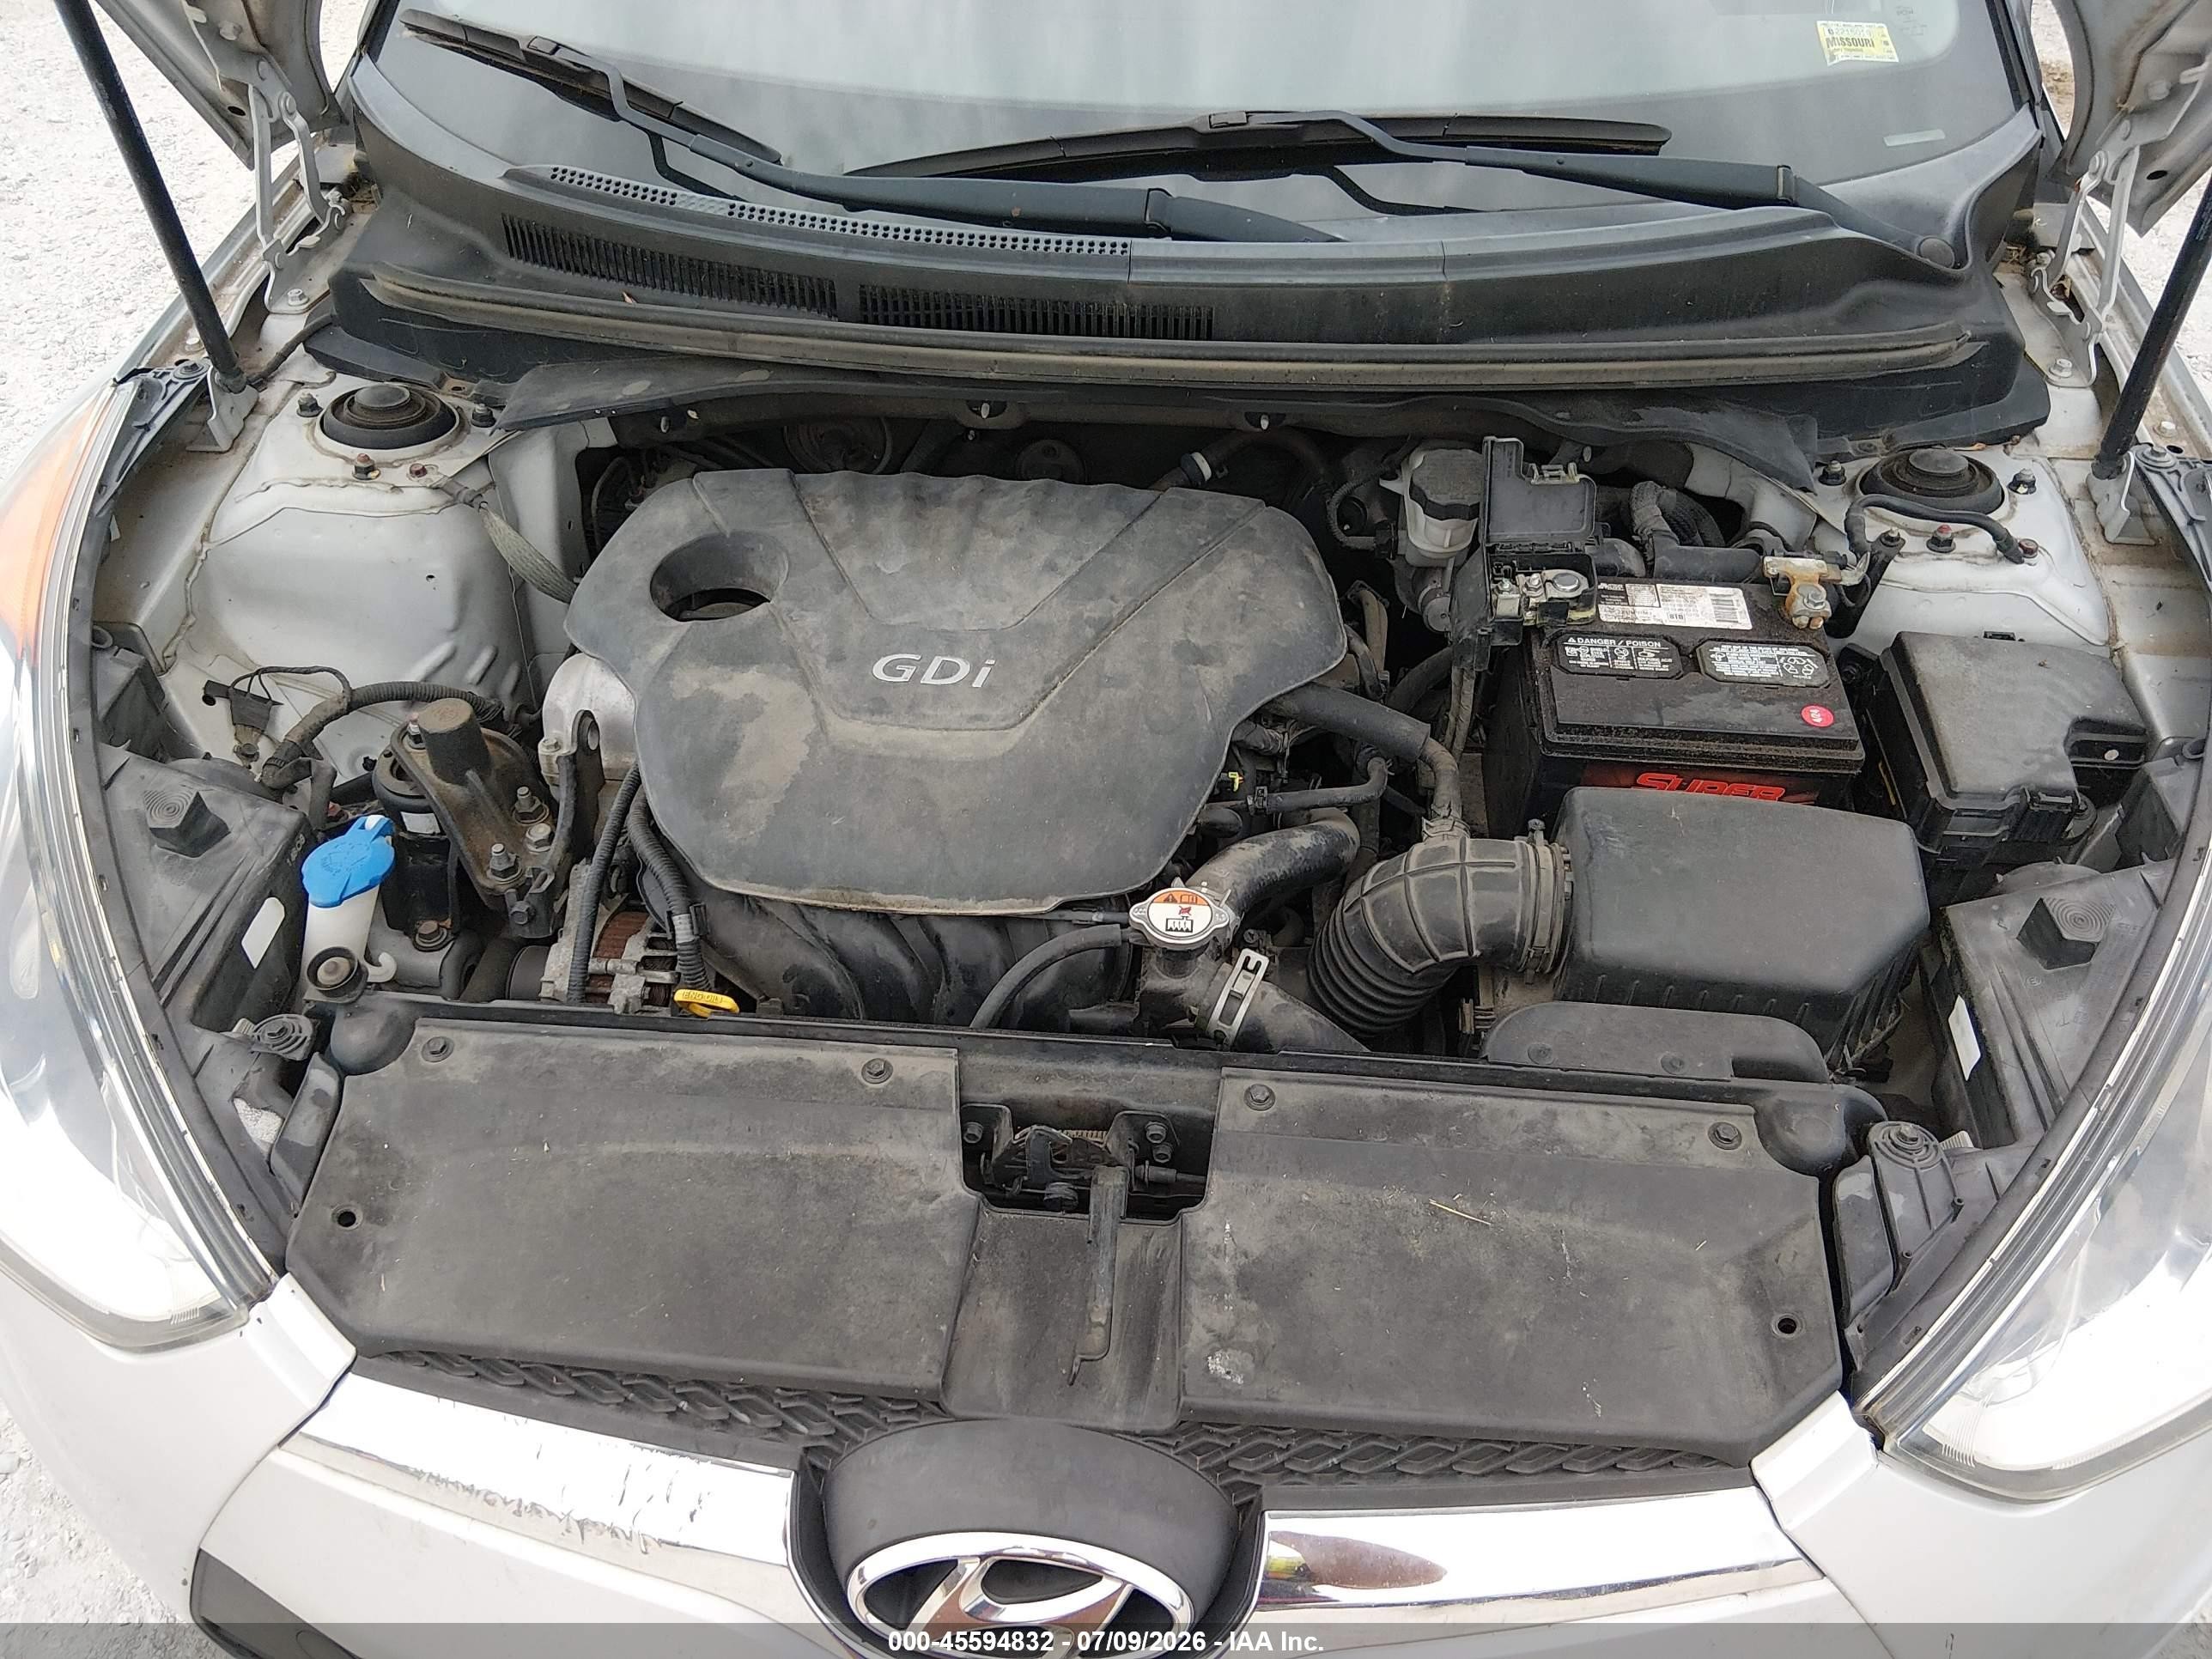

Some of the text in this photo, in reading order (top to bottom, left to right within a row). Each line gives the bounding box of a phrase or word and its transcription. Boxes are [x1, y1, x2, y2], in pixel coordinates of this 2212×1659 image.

[1826, 36, 1875, 48] MISSOURI
[1577, 637, 1616, 646] DANGER
[872, 653, 996, 688] GDi
